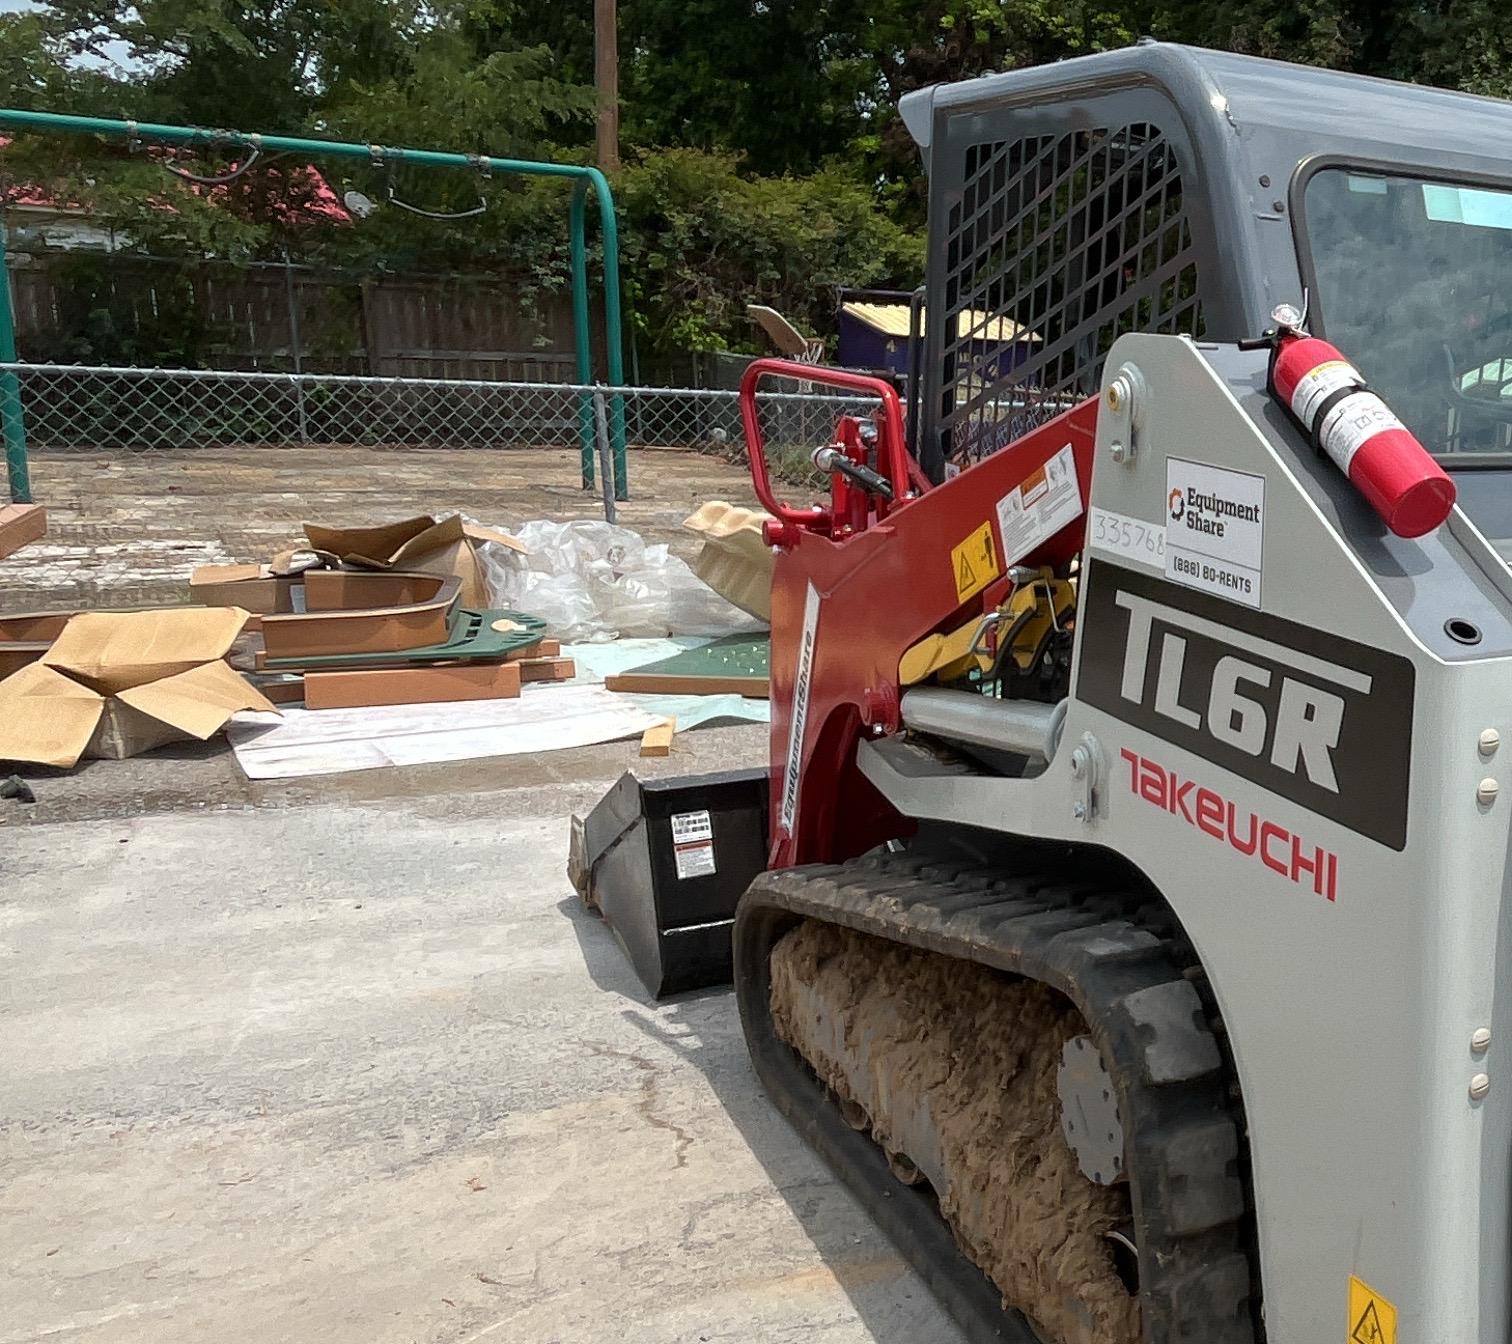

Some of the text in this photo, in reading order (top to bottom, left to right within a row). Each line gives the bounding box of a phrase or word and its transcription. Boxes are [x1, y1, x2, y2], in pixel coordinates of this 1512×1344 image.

[1187, 487, 1260, 523] Equipment
[1187, 510, 1225, 537] Share
[1096, 515, 1166, 556] 335768
[1173, 556, 1252, 594] (888) 80-RENTS
[1115, 590, 1373, 794] TL6R
